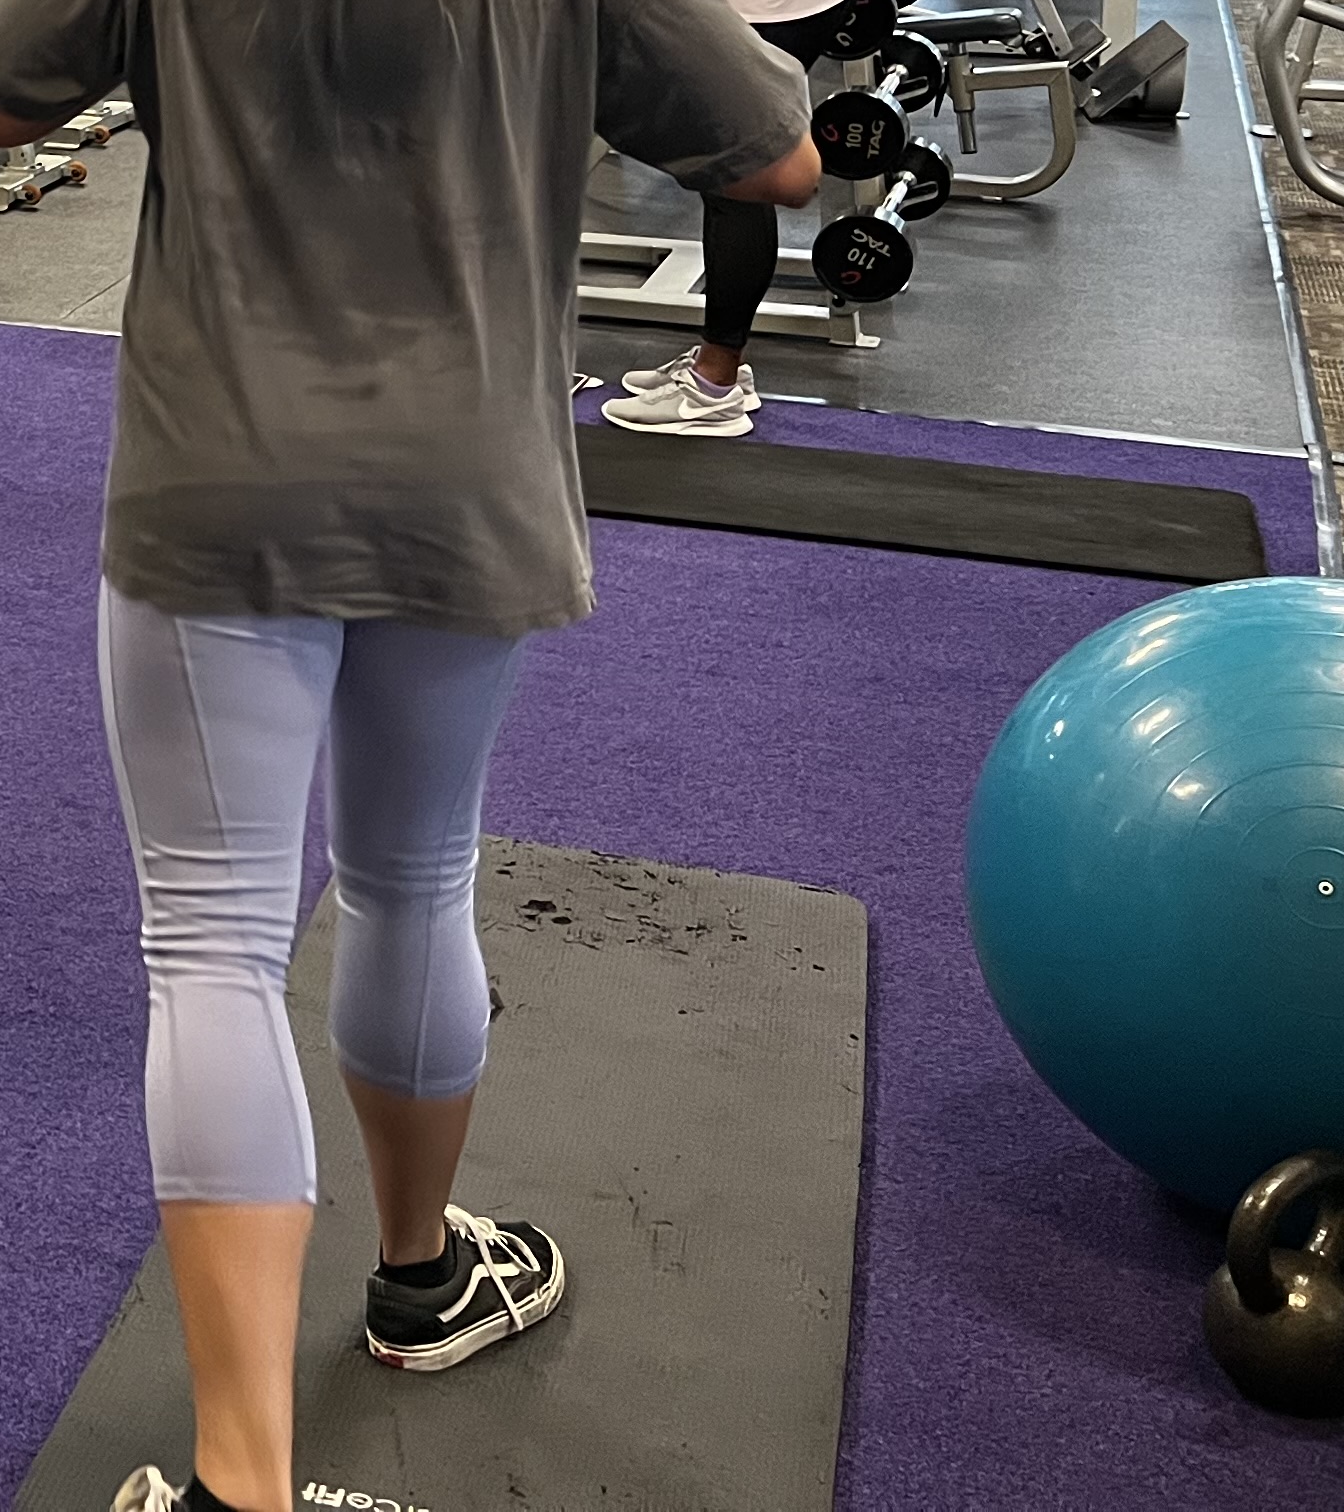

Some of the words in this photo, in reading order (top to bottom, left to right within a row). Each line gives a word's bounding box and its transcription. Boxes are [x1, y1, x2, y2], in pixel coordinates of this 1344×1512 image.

[845, 123, 864, 148] 100
[867, 119, 886, 160] TAG
[851, 228, 891, 257] TAG
[847, 247, 876, 270] 110
